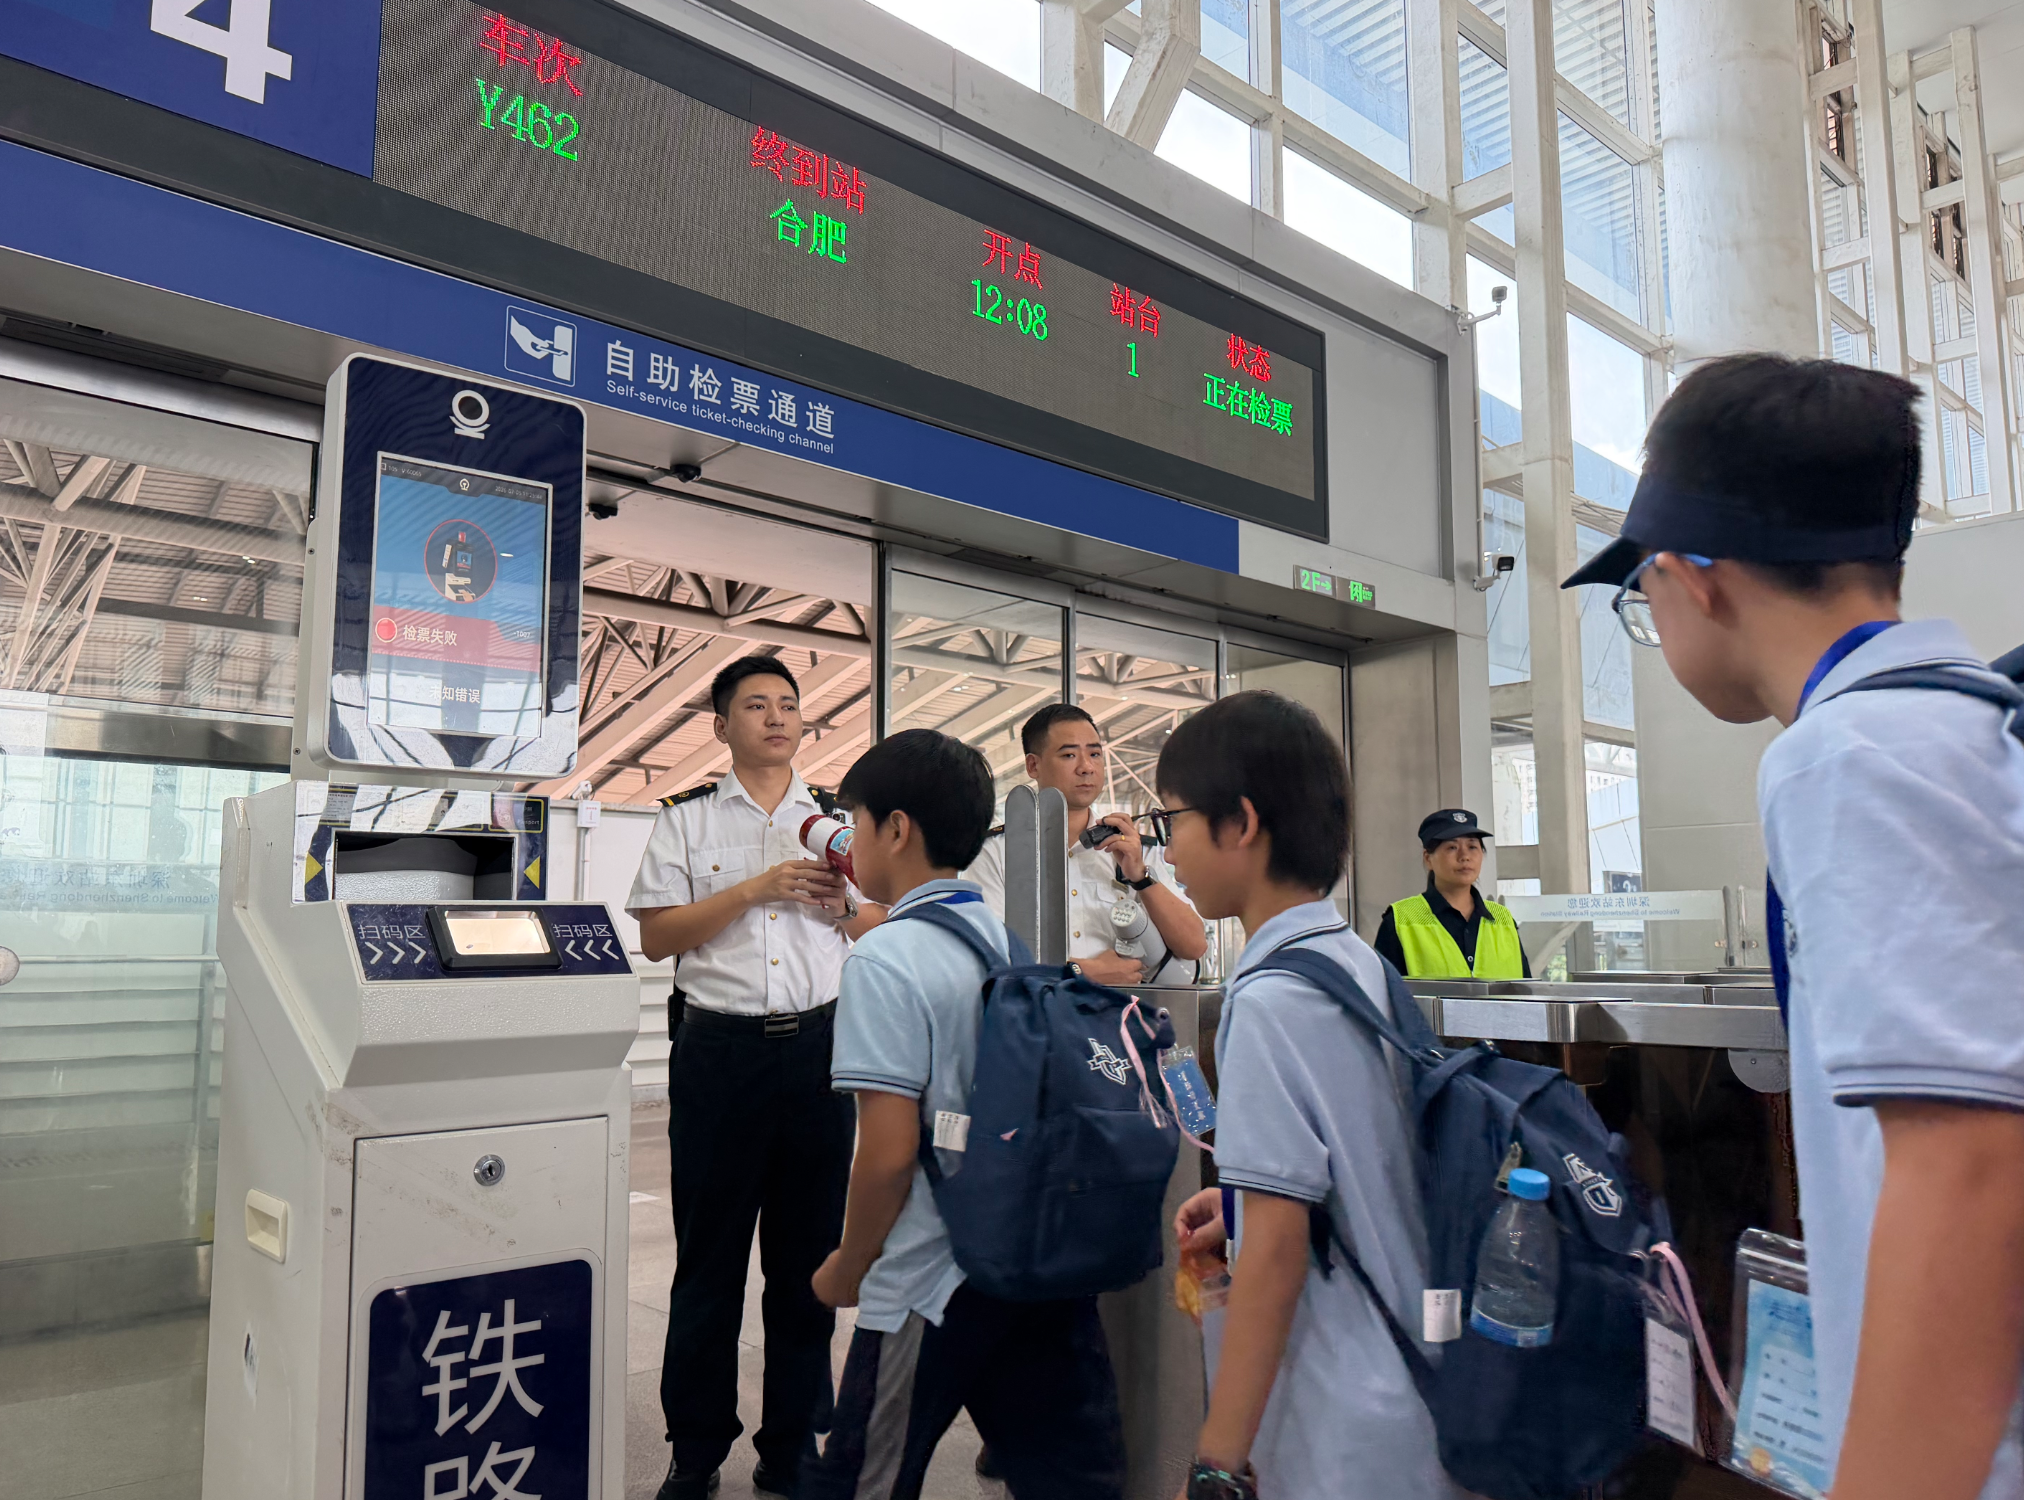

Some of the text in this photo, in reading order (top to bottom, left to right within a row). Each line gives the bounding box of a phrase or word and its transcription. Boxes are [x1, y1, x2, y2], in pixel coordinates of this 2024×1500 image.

[150, 0, 293, 104] 4
[480, 14, 582, 96] 车次
[475, 78, 579, 161] Y462
[749, 126, 867, 214] 终到站
[769, 199, 848, 264] 合肥
[982, 228, 1043, 289] 开点
[971, 279, 1048, 342] 12:08
[1109, 283, 1161, 337] 站台
[1127, 342, 1139, 378] 1
[1226, 333, 1271, 382] 状态
[606, 340, 835, 438] 自助检票通道
[606, 380, 834, 454] Self-service ticket-checking channel
[1203, 374, 1293, 436] 正在检票
[1301, 570, 1321, 591] 2F
[403, 624, 458, 647] 检票失败
[429, 685, 481, 704] 未知错误
[358, 924, 426, 940] 扫码区
[552, 923, 613, 940] 扫码区
